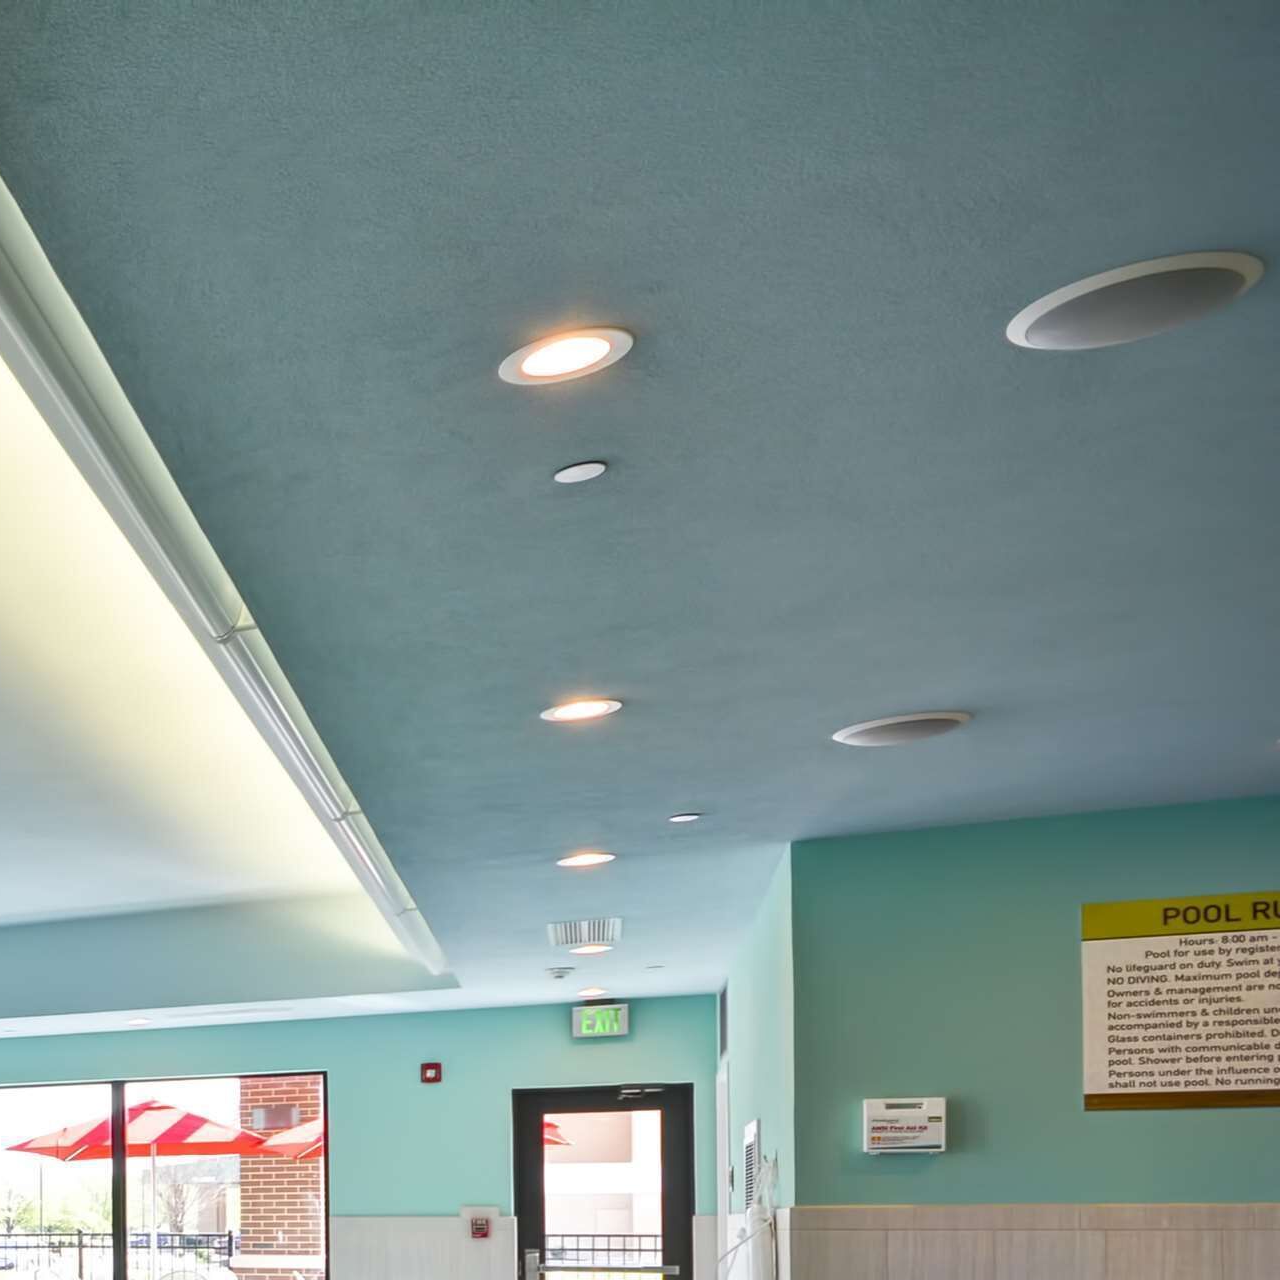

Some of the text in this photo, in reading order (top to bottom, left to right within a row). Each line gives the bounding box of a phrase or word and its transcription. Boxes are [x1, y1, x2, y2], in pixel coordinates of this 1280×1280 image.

[1162, 904, 1241, 926] POOL
[1221, 935, 1246, 944] 8:00
[1249, 935, 1268, 943] am
[1145, 950, 1170, 959] Pool
[1174, 949, 1190, 957] for
[1218, 947, 1232, 957] by
[1107, 965, 1123, 973] No
[1126, 962, 1176, 973] lifeguard
[1226, 958, 1259, 967] Swim
[1263, 957, 1274, 965] at
[1107, 977, 1124, 985] NO
[1175, 973, 1232, 983] Maximum
[1236, 970, 1260, 980] pool
[1107, 989, 1150, 998] Owners
[1154, 987, 1162, 995] &
[1166, 984, 1242, 995] management
[1107, 1000, 1123, 1008] for
[1126, 998, 1179, 1007] accidents
[1198, 995, 1244, 1005] injuries.
[1108, 1010, 1197, 1020] Non-swimmers
[1201, 1008, 1209, 1016] &
[1212, 1007, 1259, 1016] children
[581, 1008, 621, 1033] EXIT
[1108, 1020, 1183, 1031] accompanied
[1186, 1020, 1199, 1029] by
[1213, 1016, 1280, 1028] responsible
[1108, 1034, 1139, 1043] Glass
[1142, 1032, 1202, 1041] containers
[1206, 1029, 1266, 1041] prohibited.
[1108, 1047, 1154, 1055] Persons
[1158, 1045, 1182, 1053] with
[1185, 1042, 1270, 1053] communicable
[1138, 1056, 1182, 1065] Shower
[1186, 1054, 1222, 1063] before
[1226, 1053, 1274, 1063] entering
[1109, 1070, 1154, 1078] Persons
[1158, 1068, 1193, 1076] under
[1195, 1067, 1213, 1075] the
[1217, 1066, 1270, 1075] influence
[1108, 1080, 1136, 1088] shall
[1139, 1079, 1157, 1087] not
[1215, 1077, 1232, 1086] No
